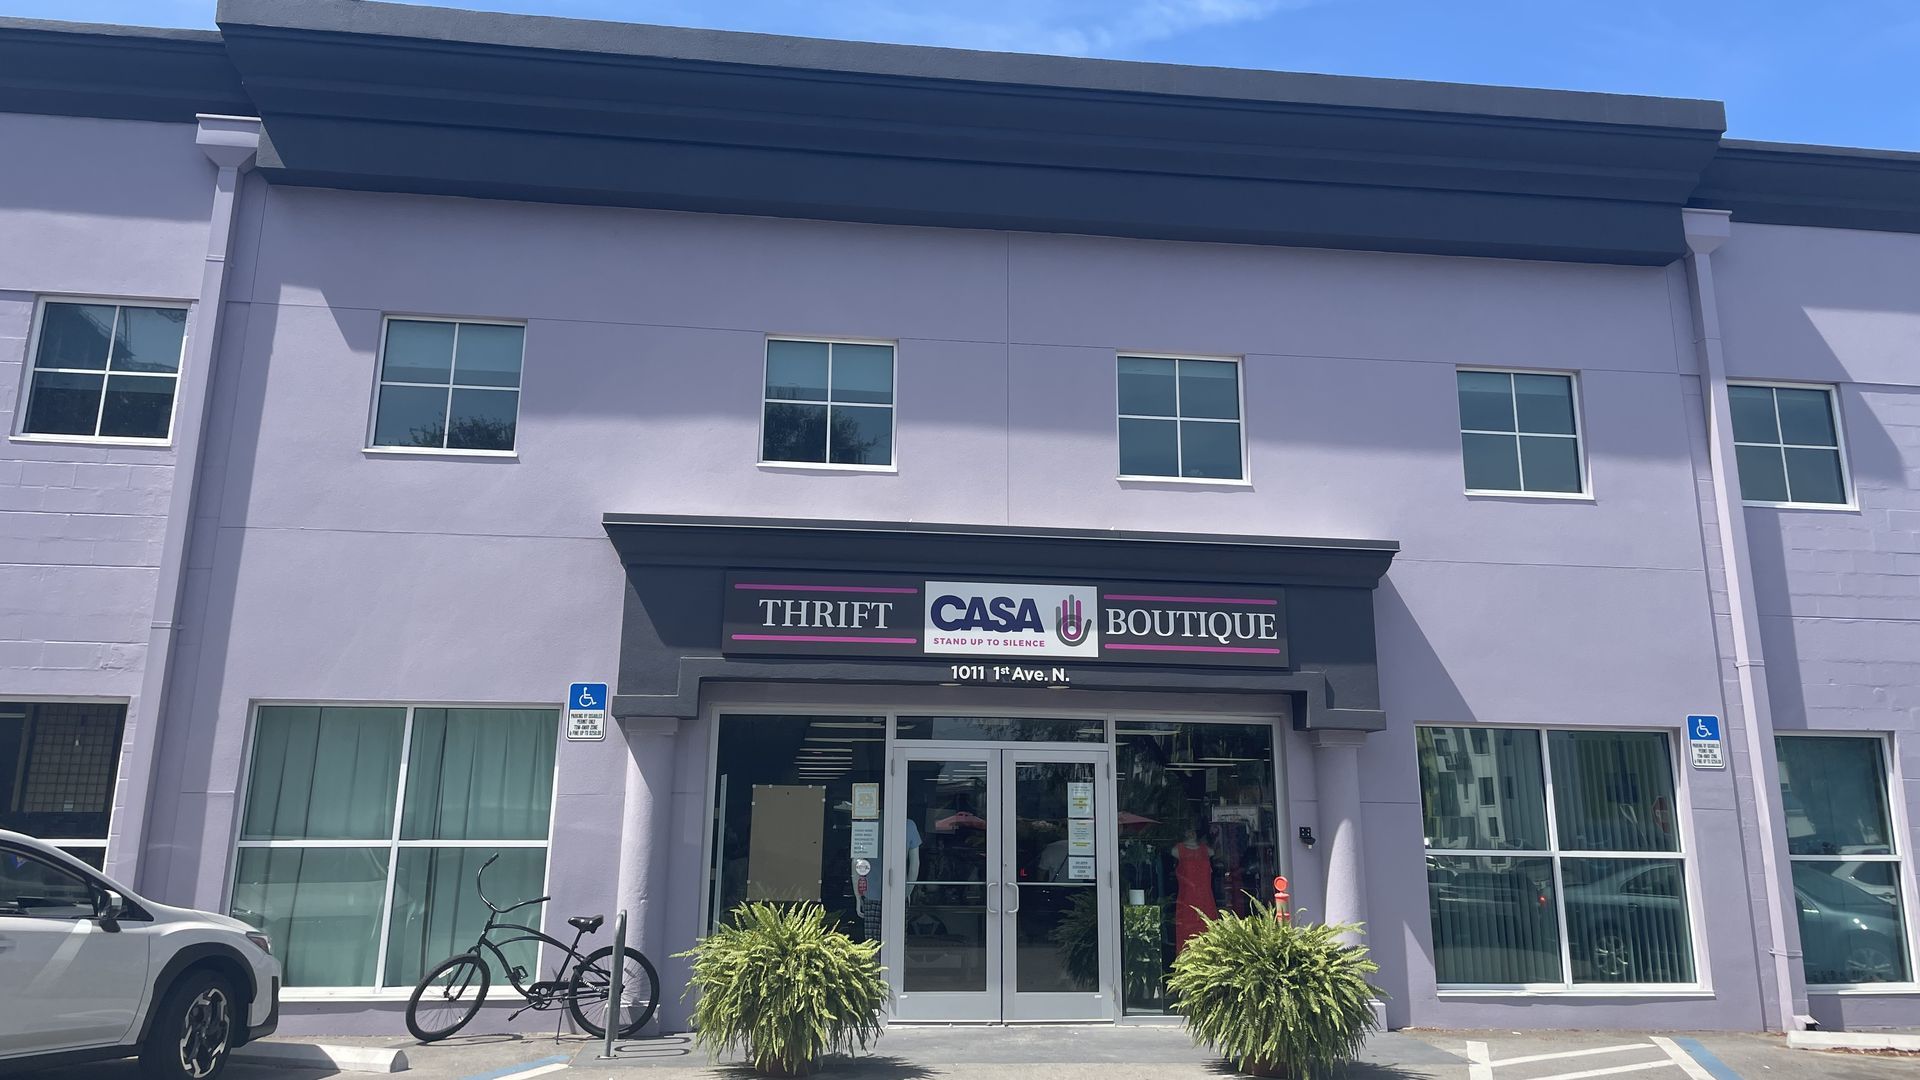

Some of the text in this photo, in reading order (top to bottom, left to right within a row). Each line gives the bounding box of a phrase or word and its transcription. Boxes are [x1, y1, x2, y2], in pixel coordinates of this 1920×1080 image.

[759, 599, 893, 629] THRIFT
[930, 594, 1045, 633] CASA
[1105, 608, 1278, 644] BOUTIQUE
[933, 637, 1045, 648] STAND UP TO SILENCE
[950, 665, 1070, 682] 1011 1st Ave. N.
